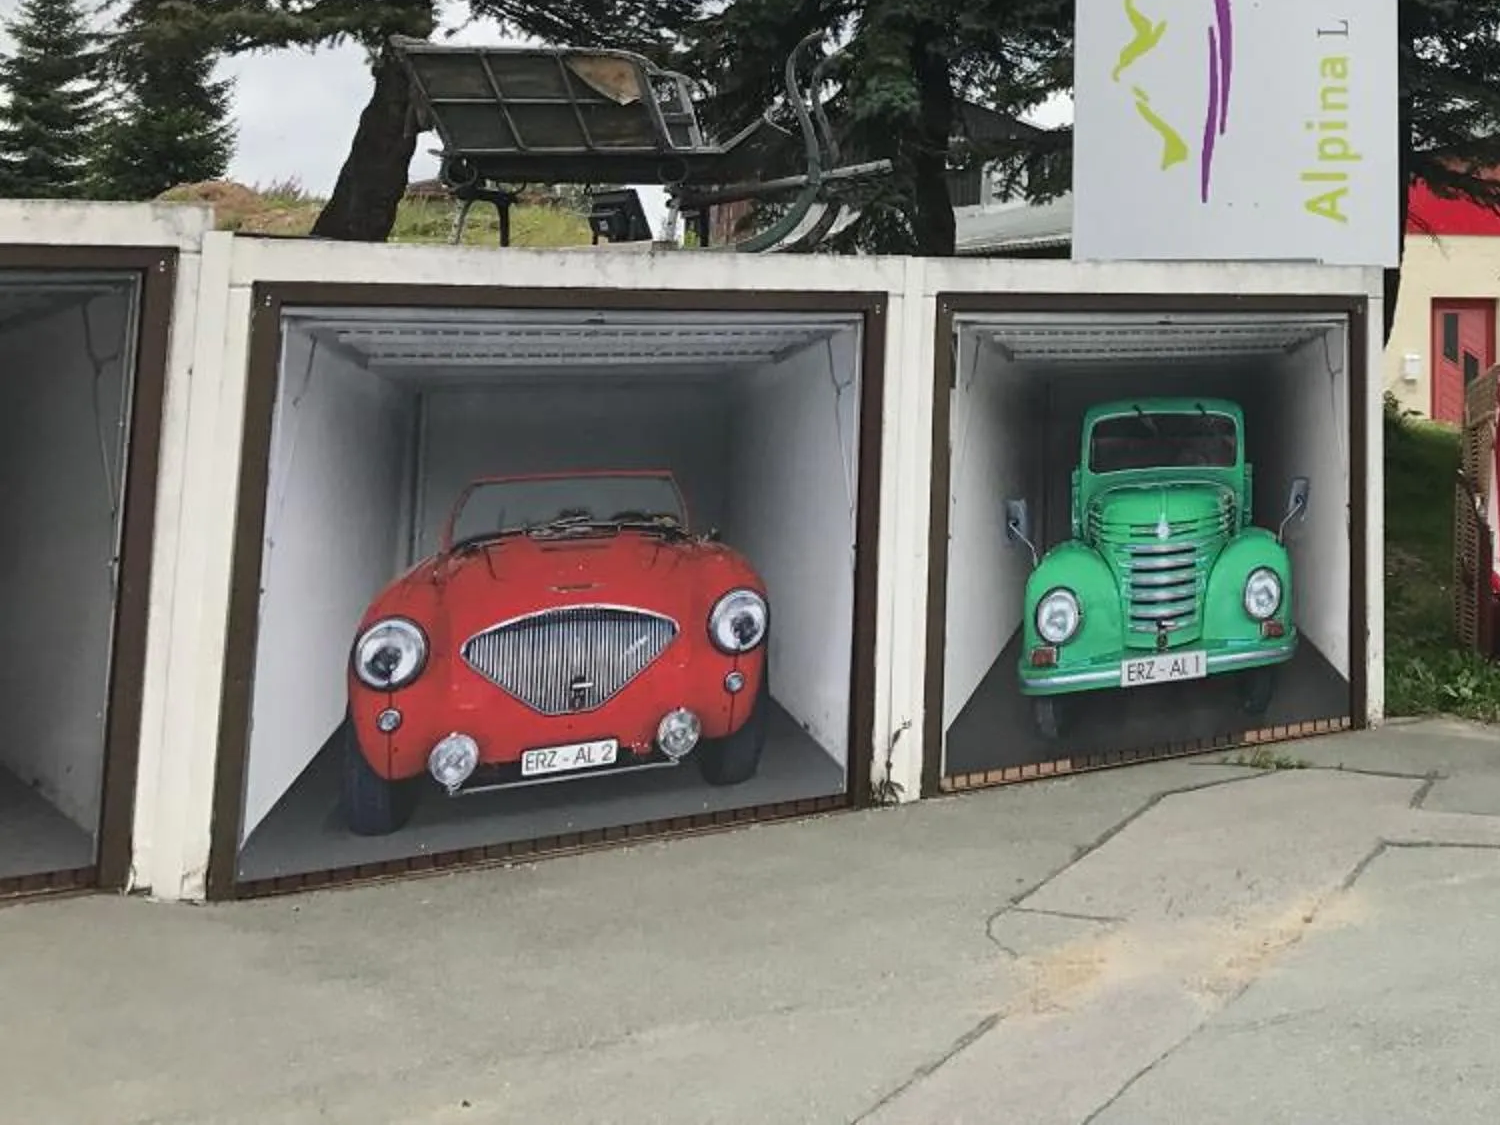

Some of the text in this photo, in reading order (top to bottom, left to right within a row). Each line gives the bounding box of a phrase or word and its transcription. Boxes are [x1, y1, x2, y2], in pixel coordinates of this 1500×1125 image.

[1301, 55, 1362, 223] Alpina
[1127, 660, 1156, 681] ERZ
[1169, 657, 1188, 677] AL
[525, 750, 558, 771] ERZ
[573, 746, 595, 764] AL
[602, 743, 613, 762] 2
